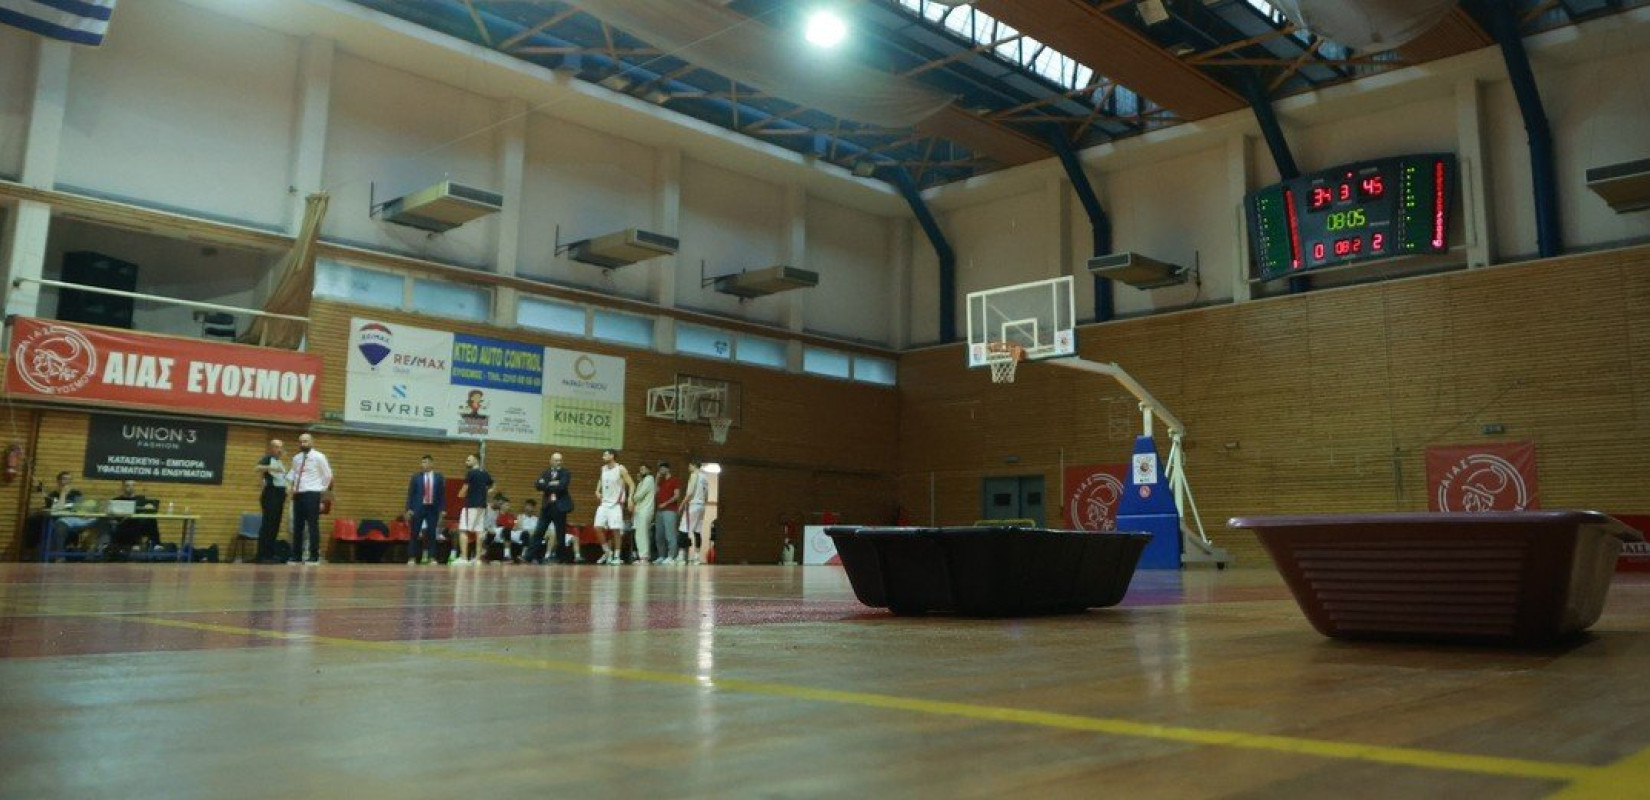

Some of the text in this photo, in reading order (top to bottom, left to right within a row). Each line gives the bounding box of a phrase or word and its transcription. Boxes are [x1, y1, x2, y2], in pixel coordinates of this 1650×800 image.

[1314, 177, 1383, 207] 34 3 45
[1314, 243, 1324, 258] 0
[1373, 233, 1382, 249] 2
[393, 353, 446, 370] RE/MAX
[102, 351, 316, 404] ΑΙΑΣ ΕΥΟΣΜΟΥ
[360, 400, 435, 417] SIVRIS
[553, 410, 612, 427] ΚΙΝΕΖΟΣ
[122, 425, 183, 442] UNION
